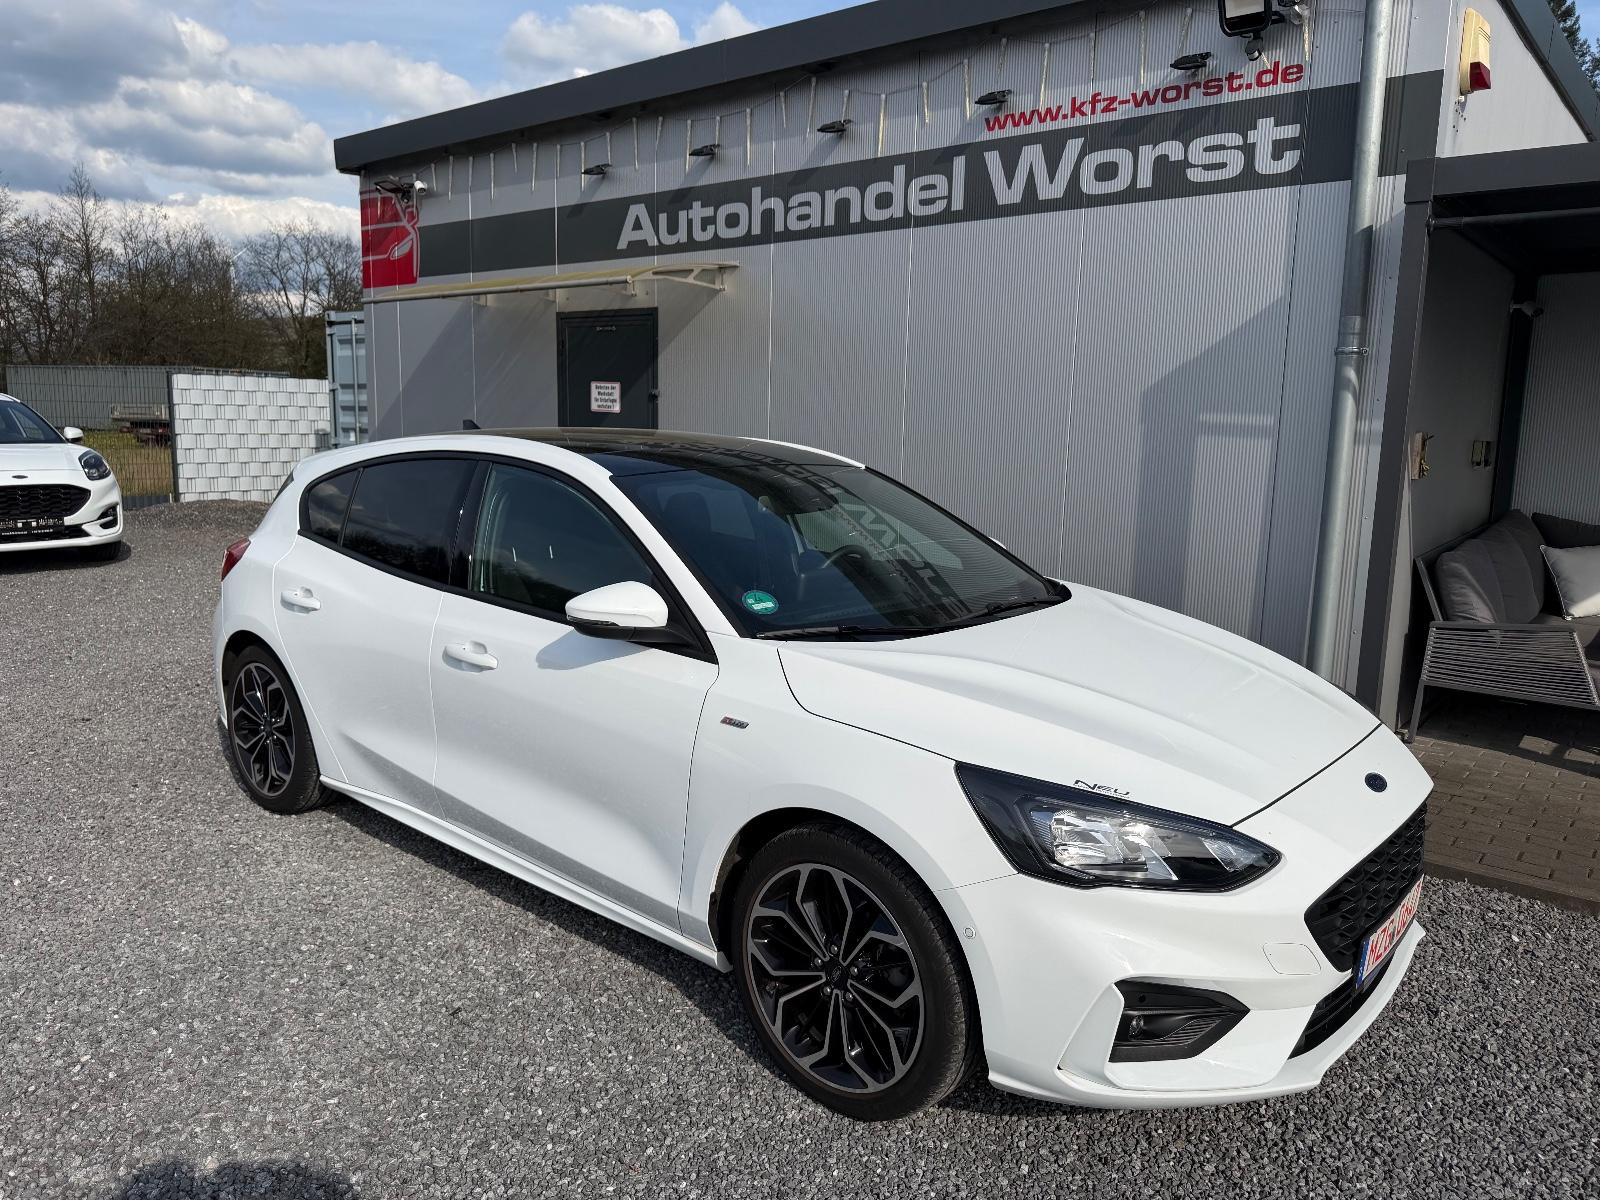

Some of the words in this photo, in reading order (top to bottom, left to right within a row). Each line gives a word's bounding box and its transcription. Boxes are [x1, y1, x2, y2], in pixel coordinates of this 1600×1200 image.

[984, 61, 1304, 132] www.kfz-worst.de
[616, 155, 966, 249] Autohandel
[984, 117, 1301, 206] Worst
